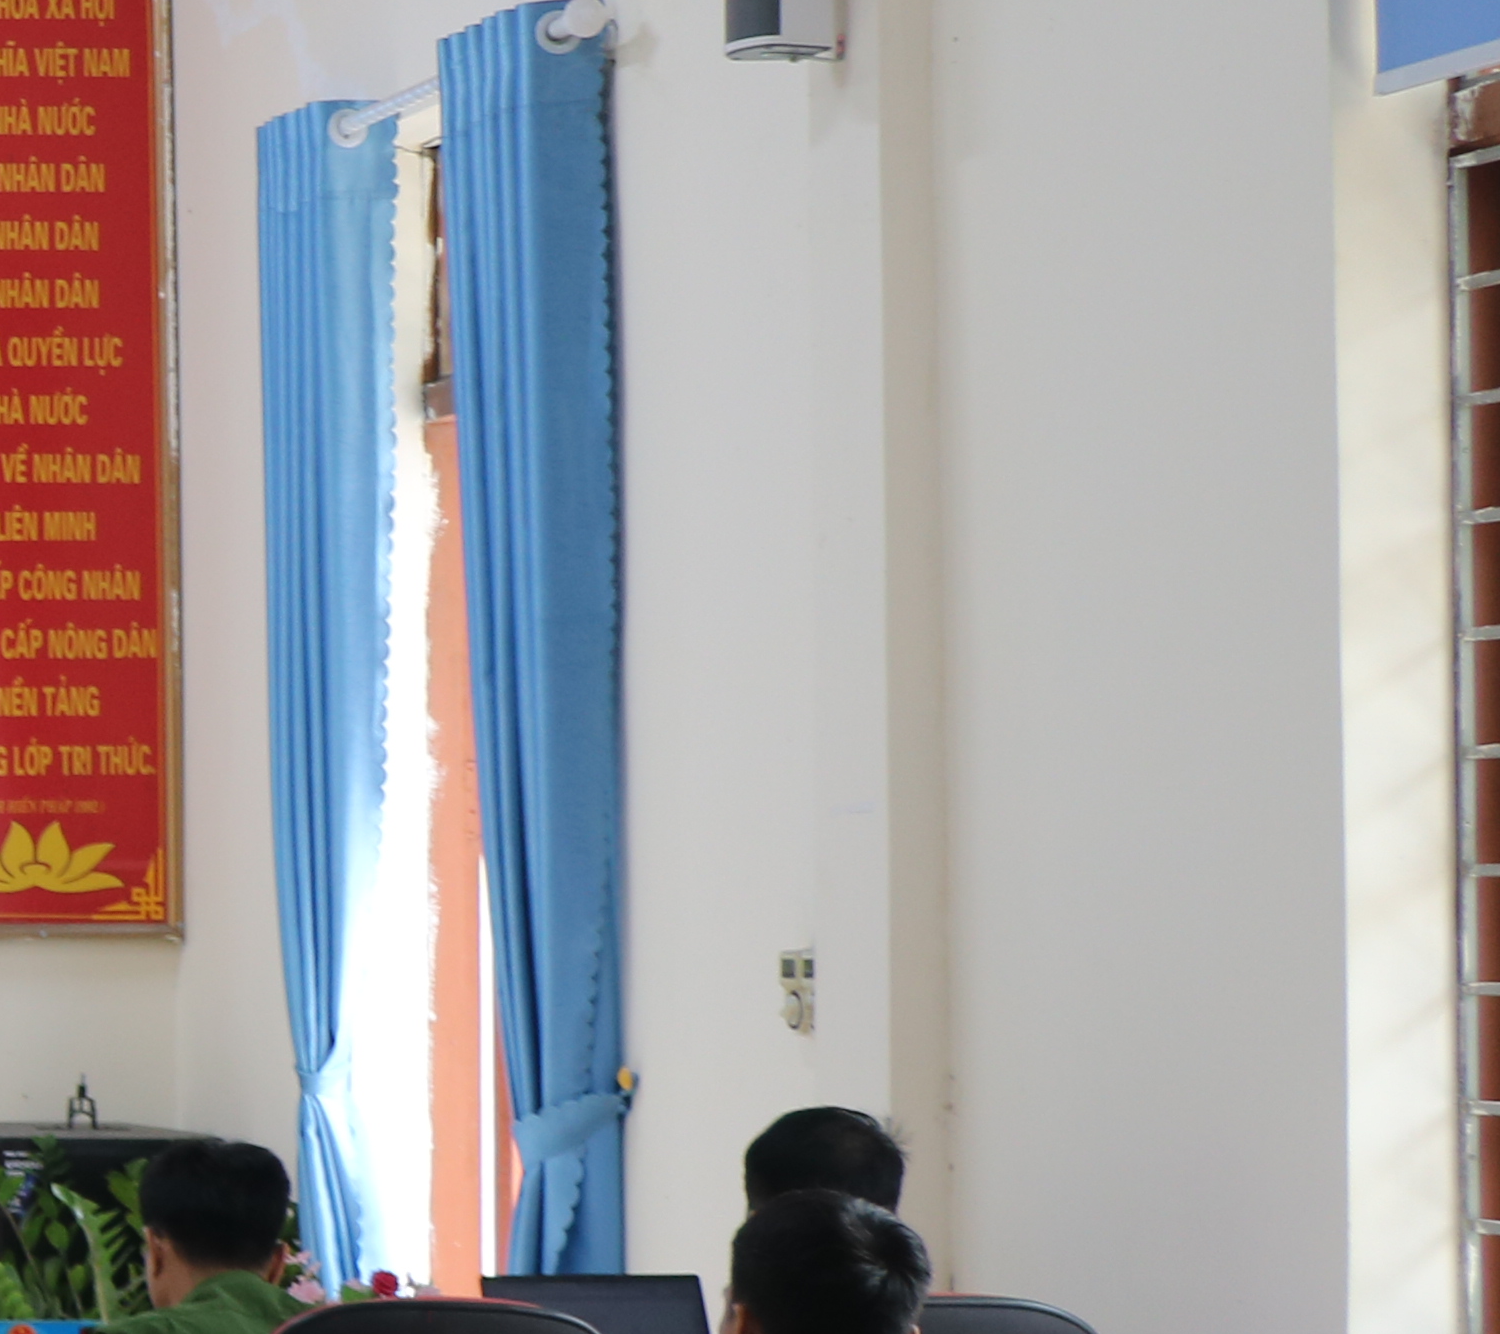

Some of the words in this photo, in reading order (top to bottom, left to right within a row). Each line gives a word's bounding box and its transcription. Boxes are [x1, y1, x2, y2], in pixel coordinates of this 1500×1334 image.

[33, 40, 80, 84] VIỆT
[83, 47, 131, 78] NAM
[36, 97, 97, 136] NƯỚC
[60, 155, 106, 193] DÂN
[54, 214, 100, 251] DÂN
[54, 271, 100, 309] DÂN
[29, 386, 89, 426] NƯỚC
[0, 443, 29, 484] VỀ
[32, 446, 92, 484] NHÂN
[95, 447, 141, 484] DÂN
[43, 511, 97, 542] MINH
[81, 563, 141, 601] NHÂN
[47, 622, 109, 660] NÔNG
[112, 621, 158, 659] DÂN
[41, 675, 101, 717] TẢNG
[58, 745, 93, 776] TRI
